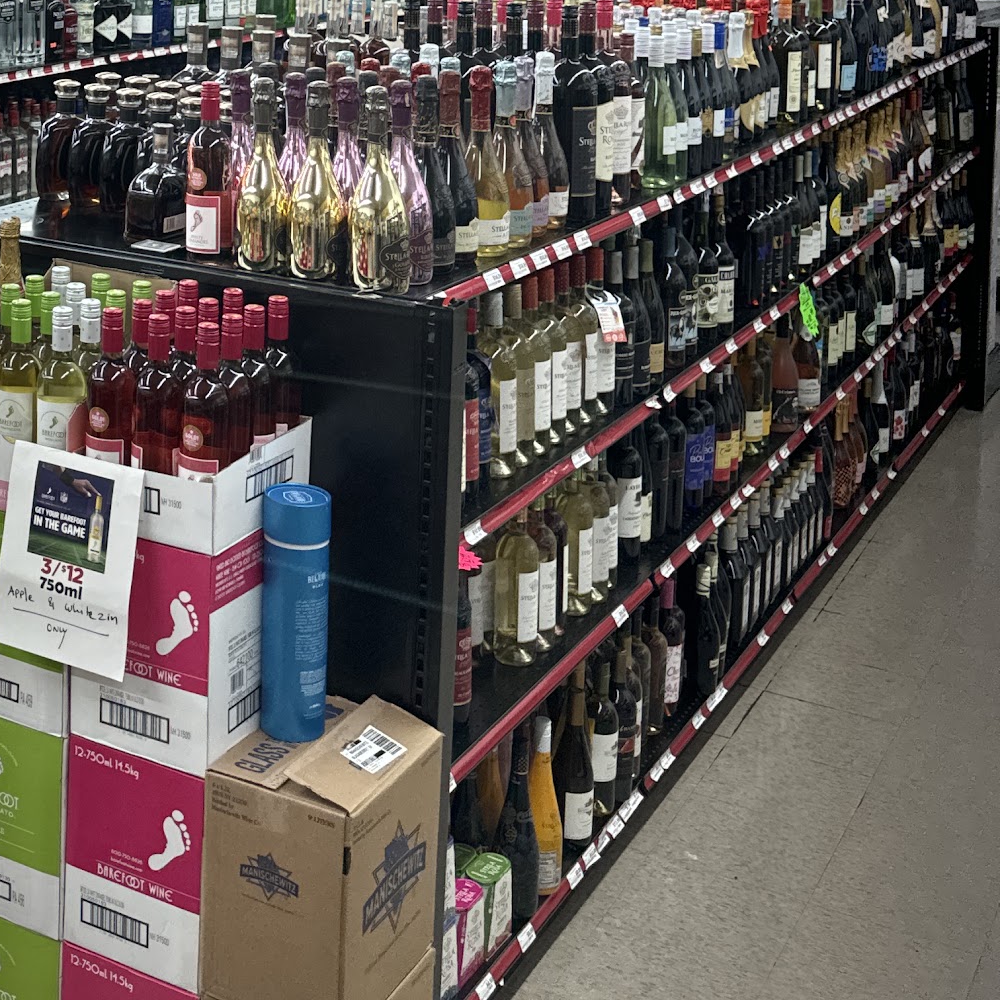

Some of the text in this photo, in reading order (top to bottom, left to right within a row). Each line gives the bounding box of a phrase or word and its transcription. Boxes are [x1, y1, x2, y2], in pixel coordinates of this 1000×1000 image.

[34, 516, 86, 539] IN THE GAME
[35, 506, 86, 526] GET YOUR BAREFOOT
[40, 557, 84, 584] 3/$12
[8, 586, 34, 602] Apple
[40, 577, 83, 600] 750ml
[126, 660, 182, 687] EFOOT WINE
[74, 745, 140, 779] 12-750ml 14.5kg
[235, 742, 290, 773] GLASS
[97, 862, 144, 892] BAREFOOT
[148, 882, 174, 903] WINE
[241, 864, 299, 898] MANISCHEWITZ
[364, 844, 427, 930] MANISCHEWITZ
[70, 953, 107, 979] 12-750ml
